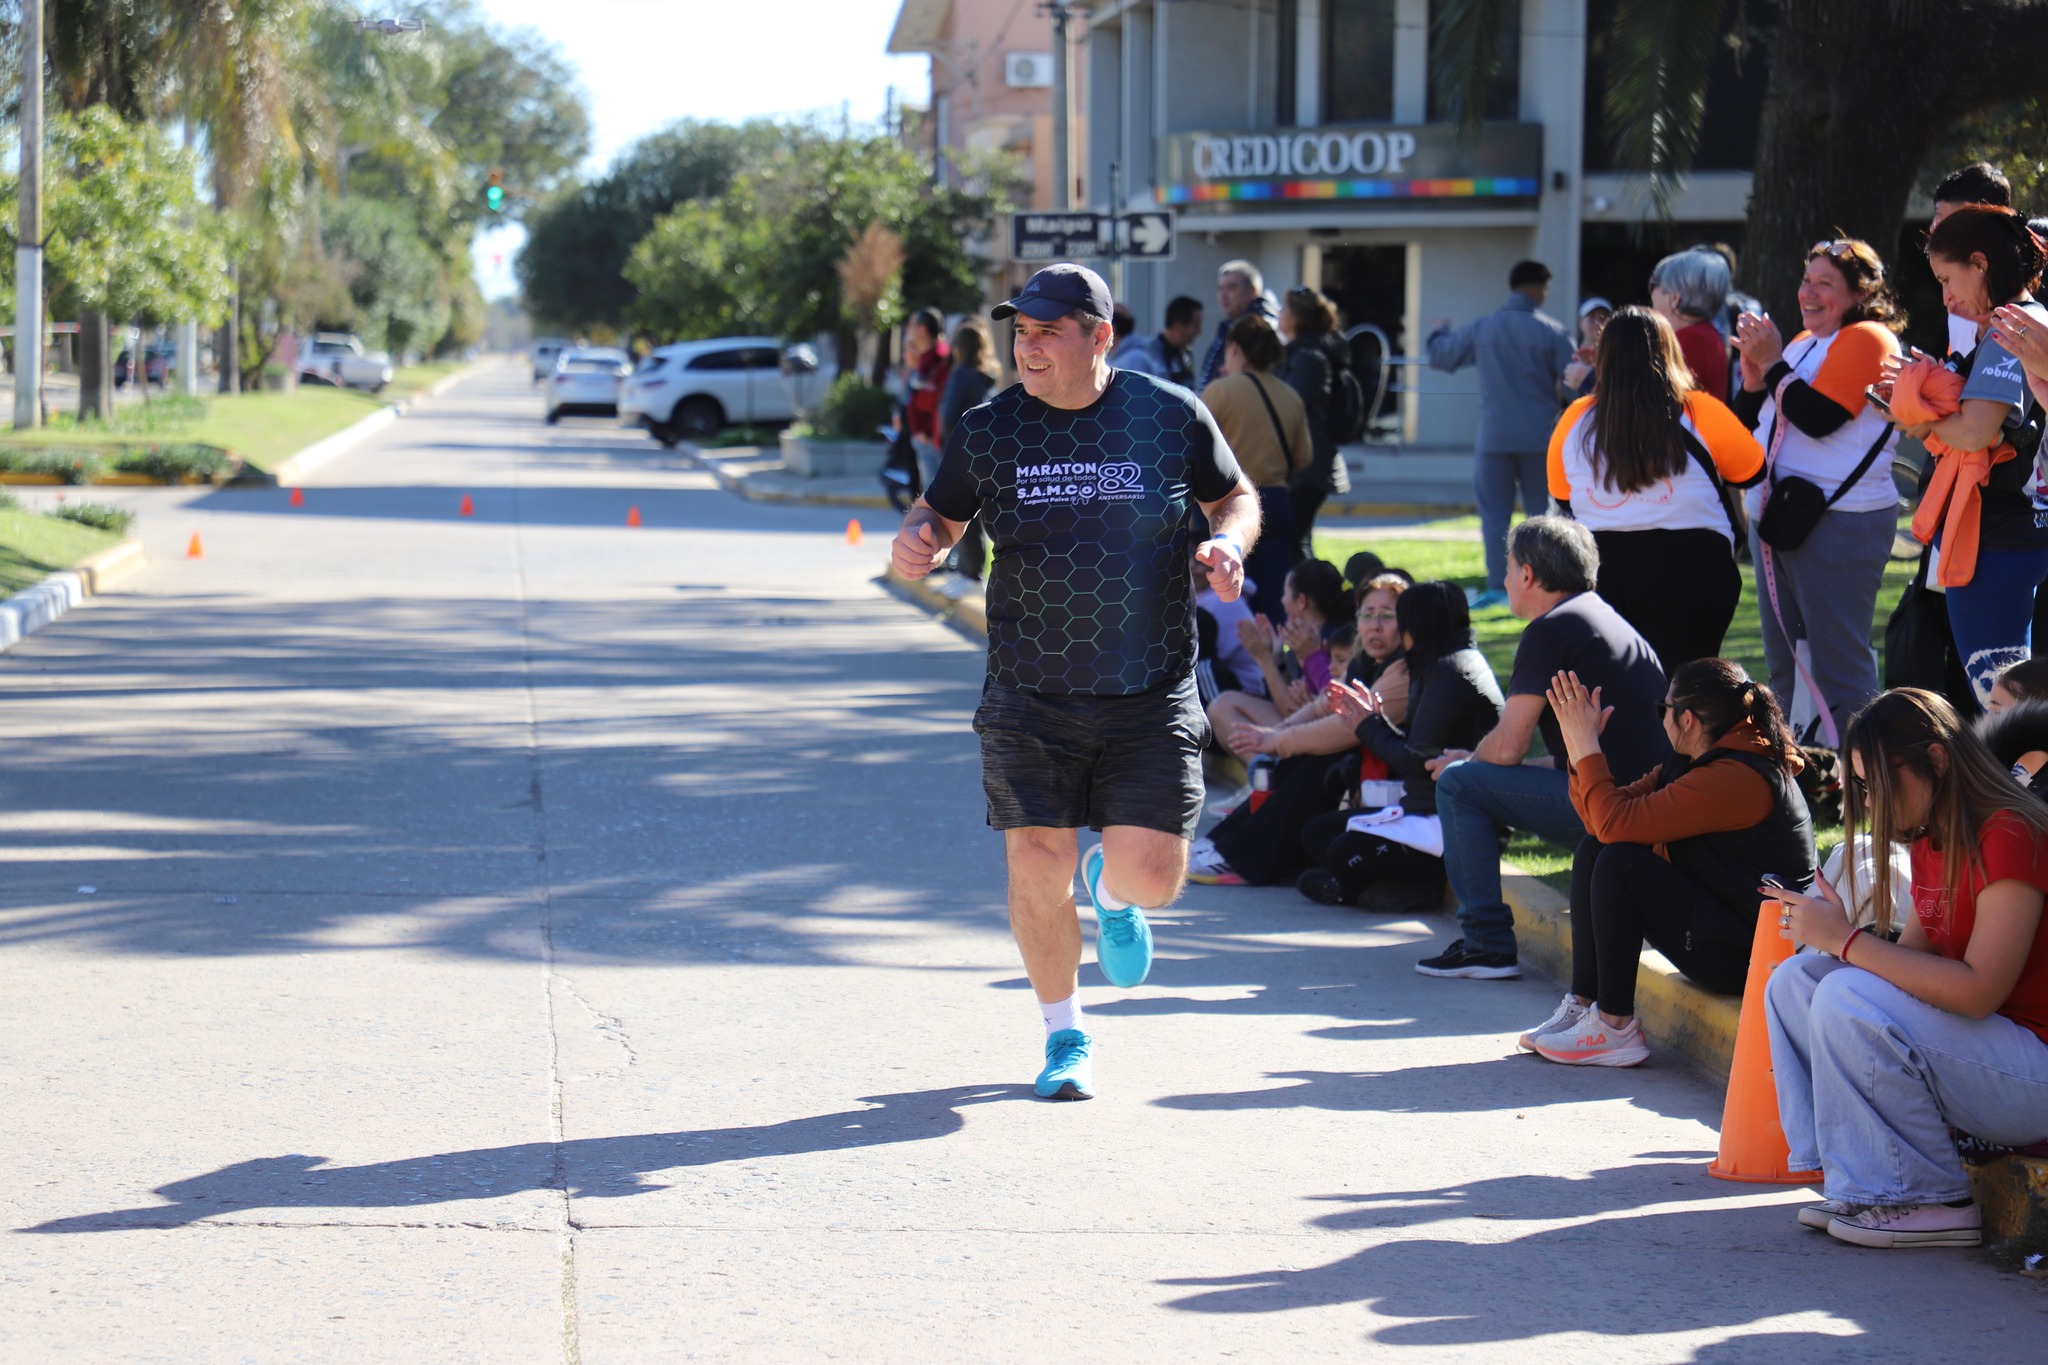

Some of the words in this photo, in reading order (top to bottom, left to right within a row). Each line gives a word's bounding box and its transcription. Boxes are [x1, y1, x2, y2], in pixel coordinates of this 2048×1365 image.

[1192, 132, 1416, 178] CREDICOOP
[1016, 462, 1097, 478] MARATON
[1097, 462, 1144, 494] 82
[1038, 475, 1060, 483] salud
[1024, 497, 1049, 505] Laguna
[1575, 1032, 1608, 1048] FILA
